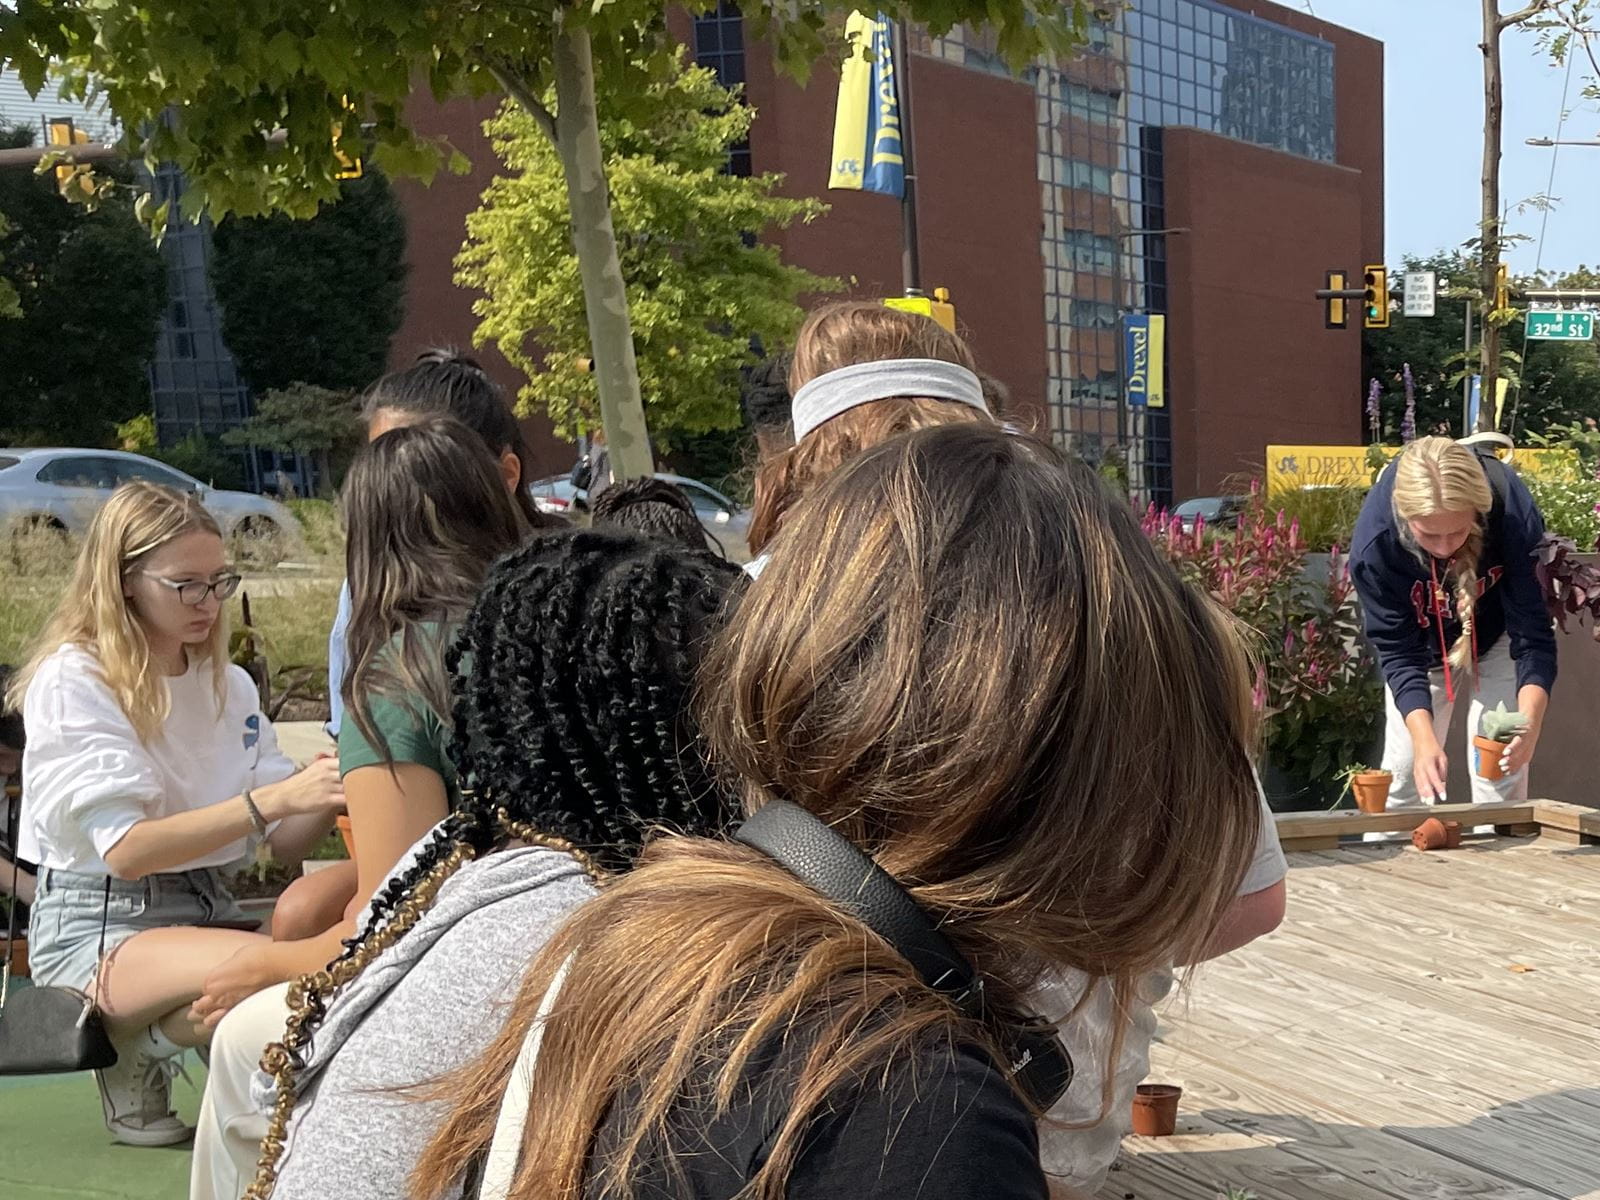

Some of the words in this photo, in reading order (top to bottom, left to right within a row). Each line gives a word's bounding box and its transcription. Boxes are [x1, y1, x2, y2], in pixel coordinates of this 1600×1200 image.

[1534, 323, 1562, 336] 32nd
[1569, 324, 1584, 336] St
[1129, 327, 1147, 392] Drexel
[1306, 456, 1372, 476] DREXE
